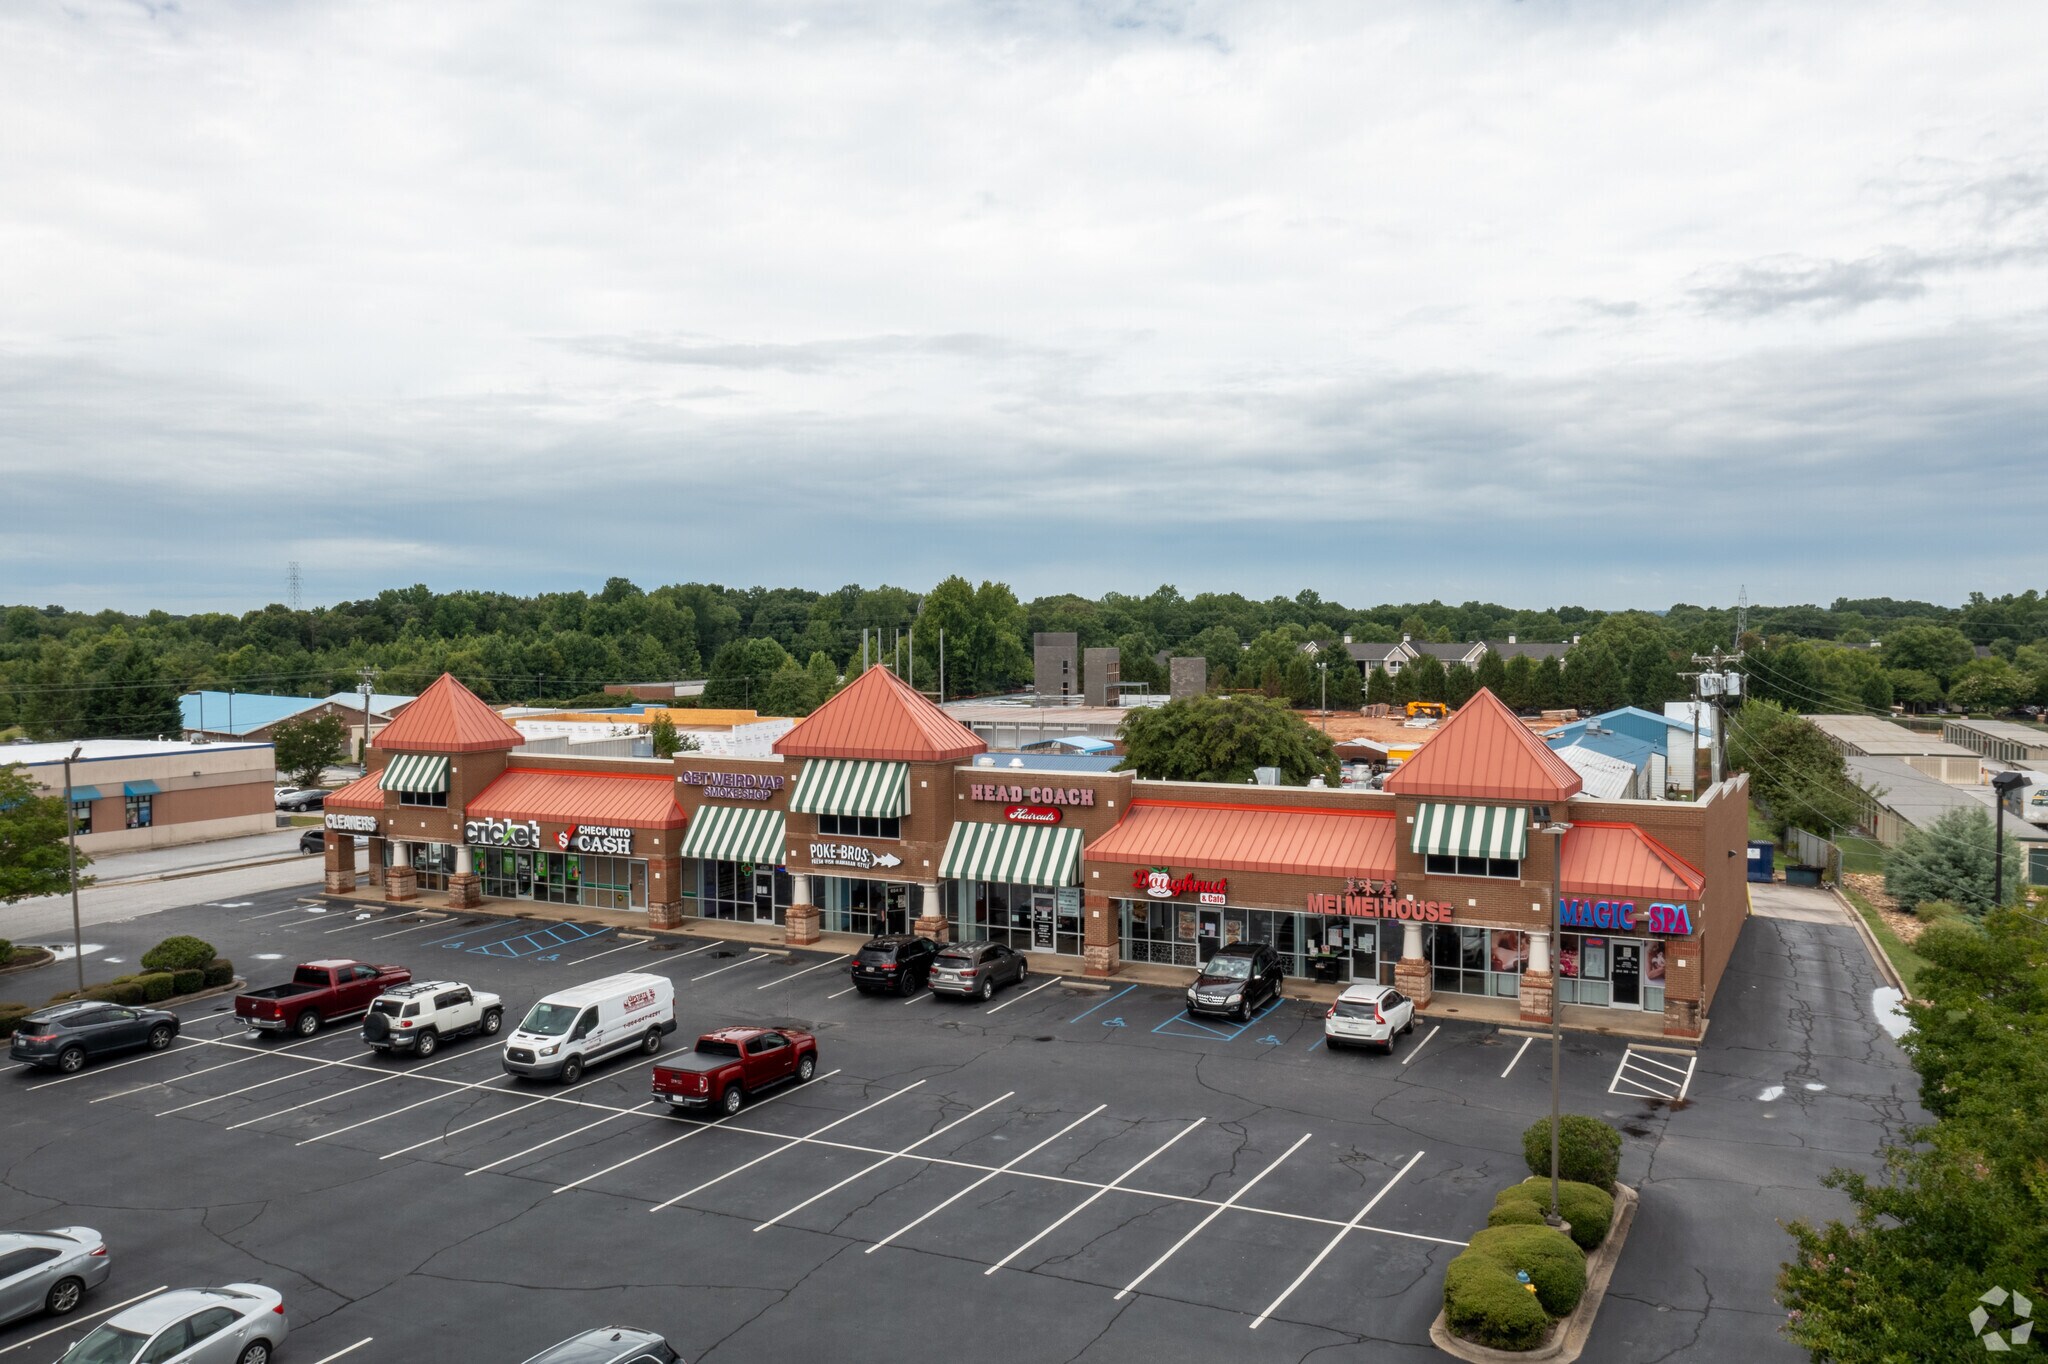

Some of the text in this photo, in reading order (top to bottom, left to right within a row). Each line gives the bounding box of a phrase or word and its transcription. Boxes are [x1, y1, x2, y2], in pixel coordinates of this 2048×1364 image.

[682, 770, 709, 785] GET
[710, 772, 756, 788] WEIRD
[703, 786, 771, 801] SMOKE SHOP
[970, 784, 1095, 806] HEAD COACH
[325, 813, 377, 832] CLEANERS
[1009, 808, 1056, 821] Haircuts
[465, 817, 540, 849] cricket
[578, 825, 631, 838] CHECK INTO
[810, 843, 837, 859] POKE
[1132, 869, 1228, 897] Doughnut
[1306, 893, 1453, 923] MEI MEI HOUSE
[1559, 897, 1693, 935] MAGIC SPA
